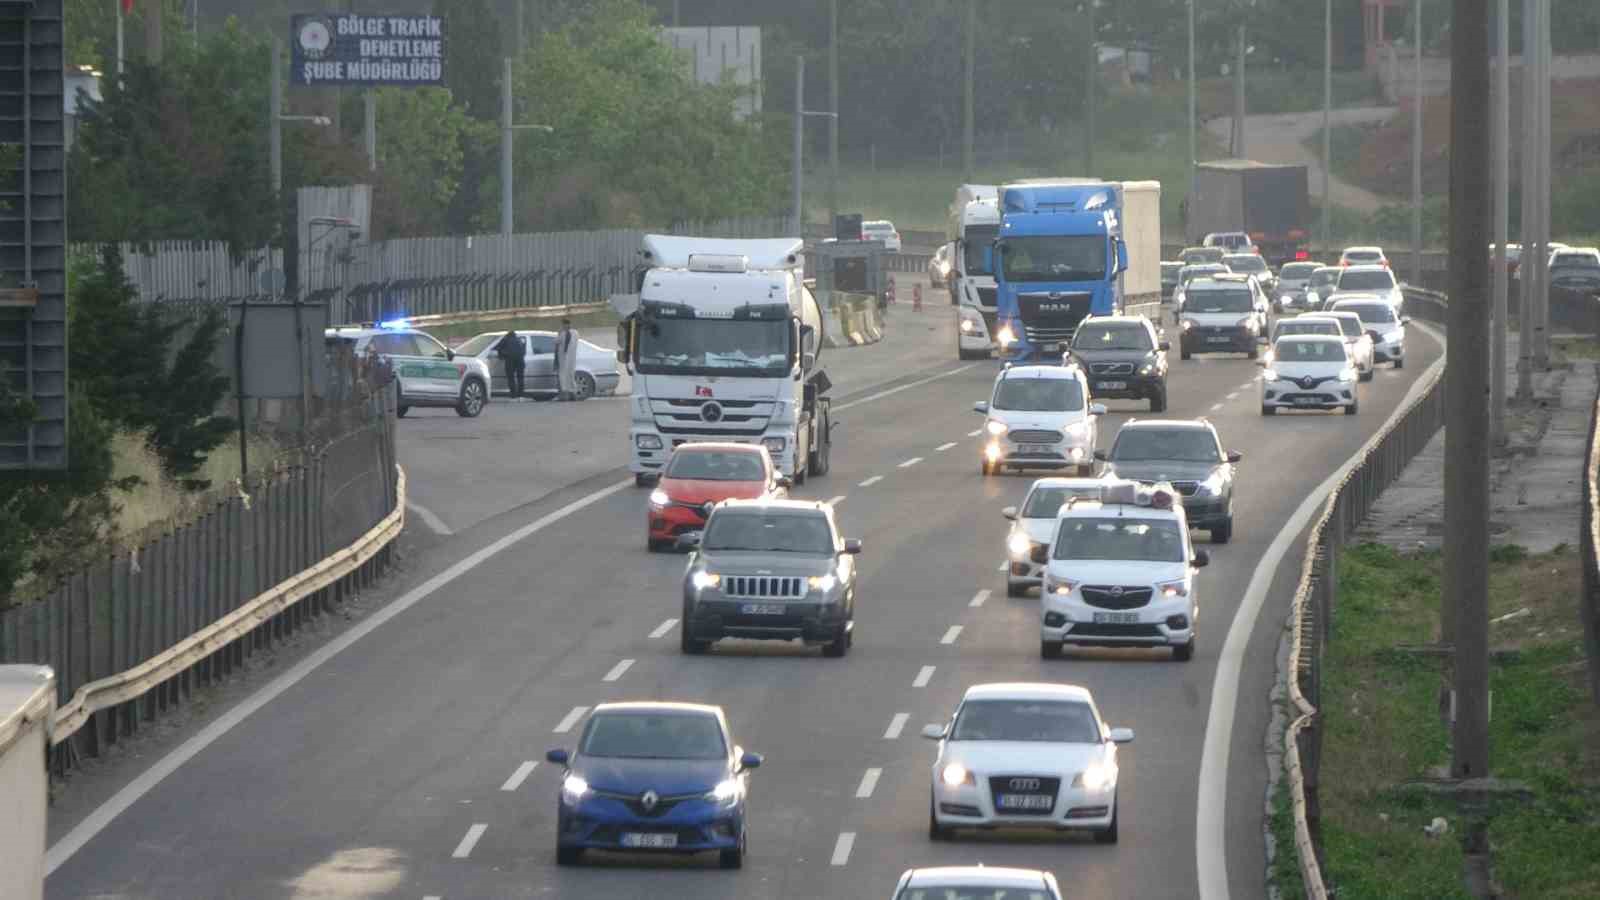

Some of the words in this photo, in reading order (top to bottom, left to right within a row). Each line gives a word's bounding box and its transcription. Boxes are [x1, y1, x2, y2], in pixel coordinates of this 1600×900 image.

[338, 14, 385, 35] BÖLGE
[389, 14, 441, 35] TRAFİK
[360, 39, 441, 57] DENETLEME
[304, 61, 344, 85] ŞUBE
[347, 58, 441, 80] MÜDÜRLÜĞÜ
